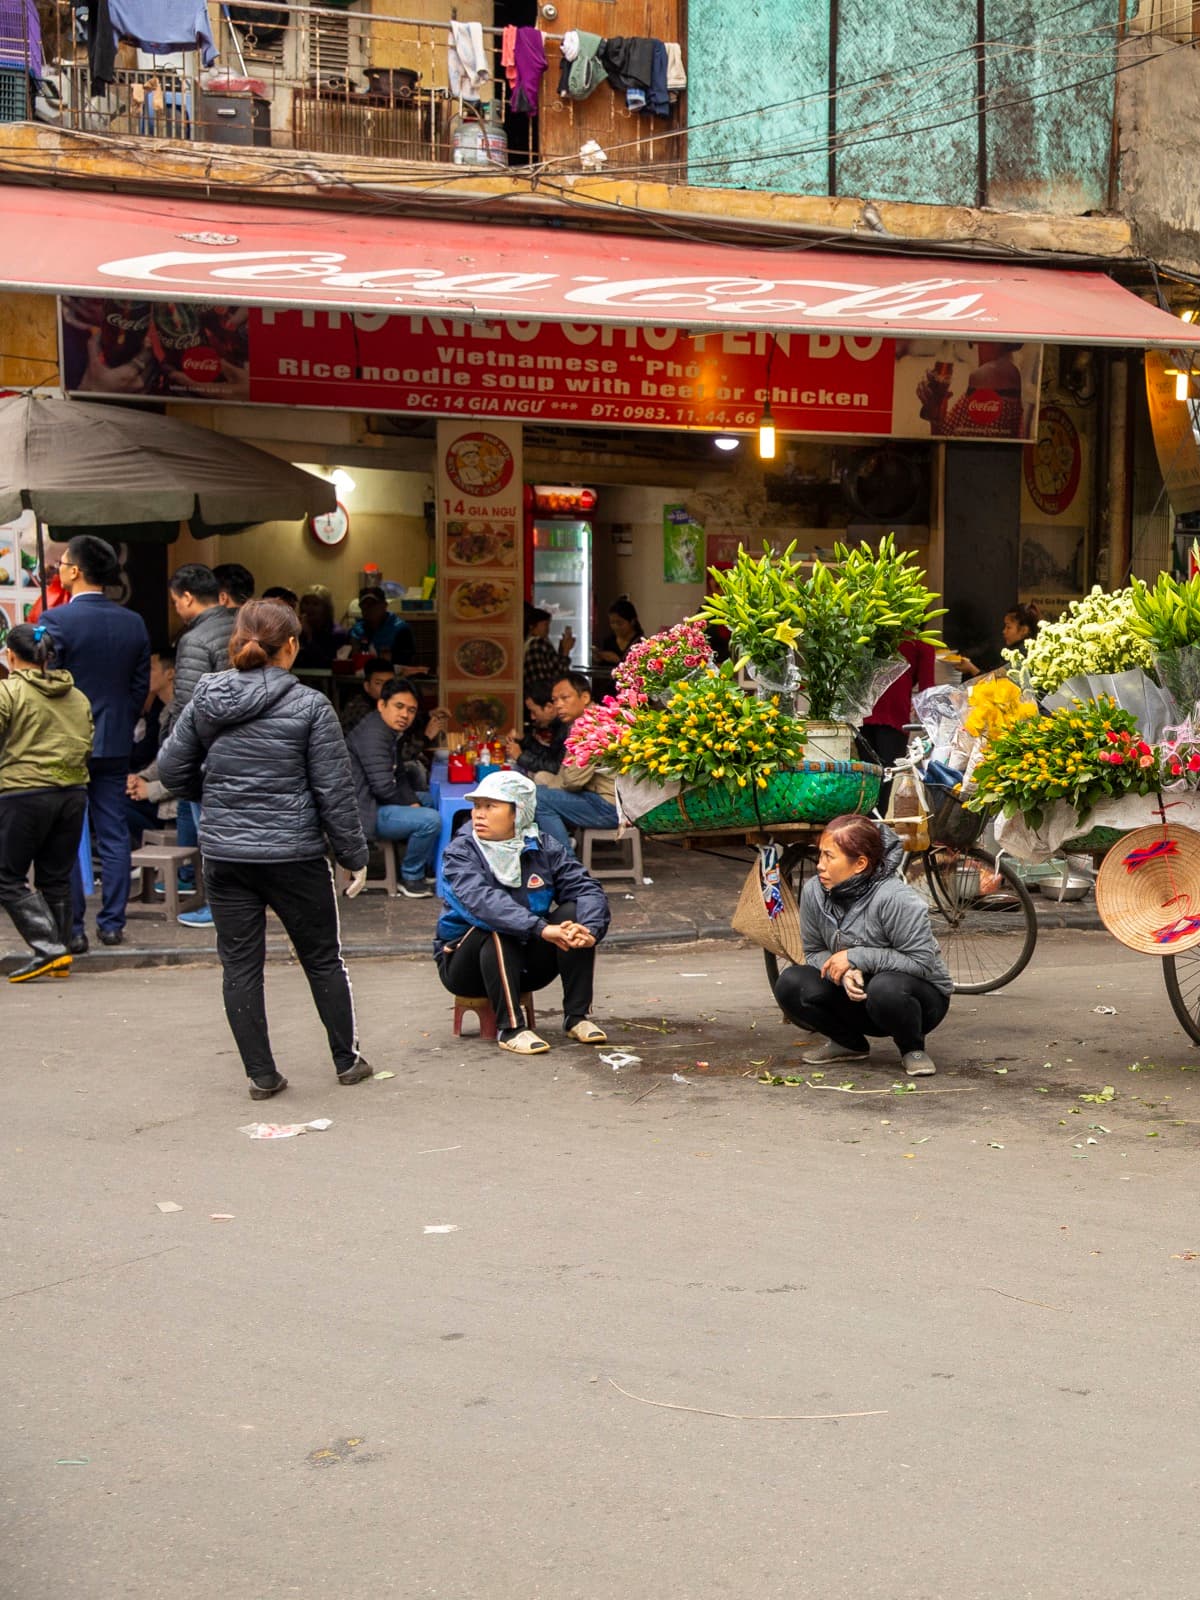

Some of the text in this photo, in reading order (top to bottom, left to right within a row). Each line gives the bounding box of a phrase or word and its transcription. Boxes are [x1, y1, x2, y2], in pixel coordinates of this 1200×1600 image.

[437, 346, 618, 373] Vietnamese
[278, 357, 351, 379] Rice
[362, 366, 471, 386] noodle
[481, 373, 555, 392] soup
[565, 377, 631, 395] with
[716, 386, 745, 402] or
[753, 386, 869, 407] chicken
[406, 393, 438, 408] ĐC:
[443, 394, 465, 409] 14
[468, 396, 499, 411] GIA
[444, 500, 464, 515] 14
[468, 506, 488, 515] GIA
